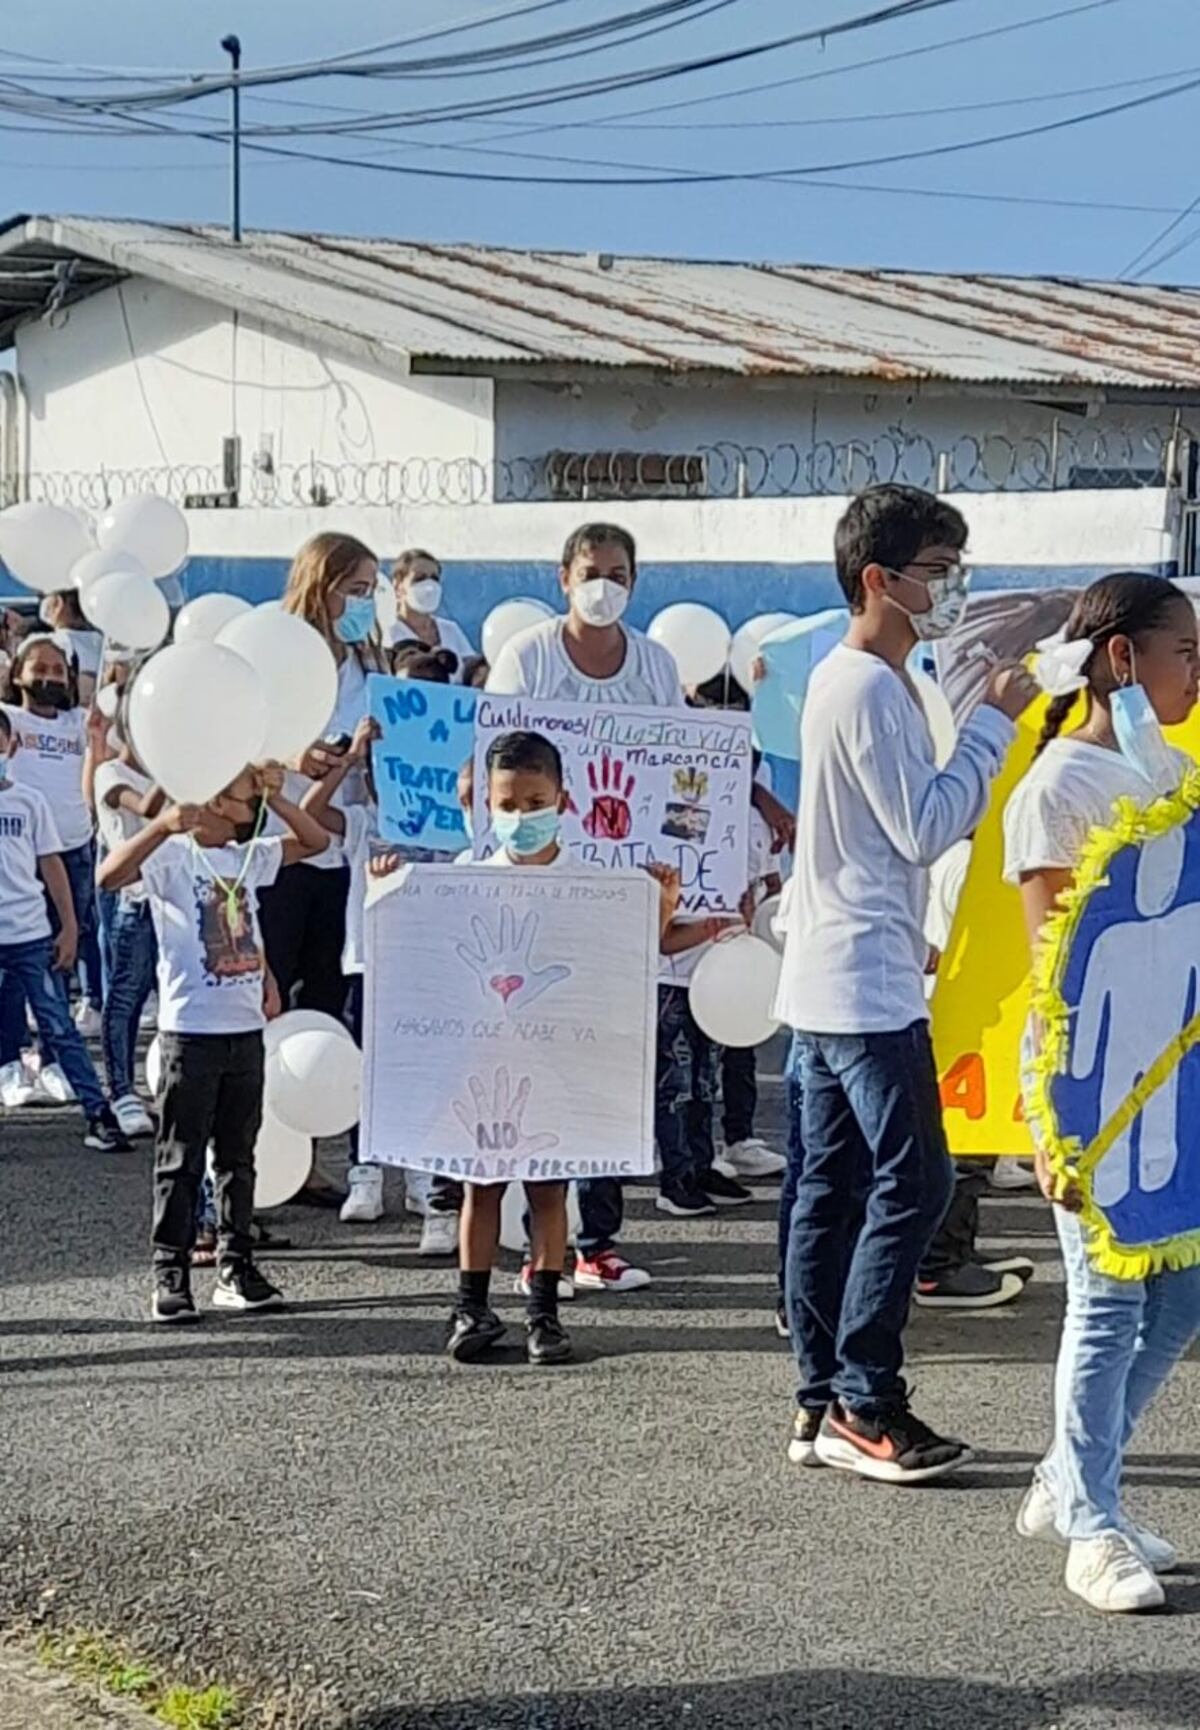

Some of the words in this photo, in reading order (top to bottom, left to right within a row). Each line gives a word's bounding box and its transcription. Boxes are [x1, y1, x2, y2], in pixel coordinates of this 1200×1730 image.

[383, 688, 427, 725] NO
[429, 718, 449, 743] A
[569, 841, 656, 868] RATA
[673, 844, 718, 891] DE
[572, 1026, 597, 1042] YA
[477, 1122, 519, 1150] NO
[421, 1157, 486, 1176] TRATA
[497, 1157, 518, 1177] DE
[528, 1159, 632, 1177] PERSONAS
